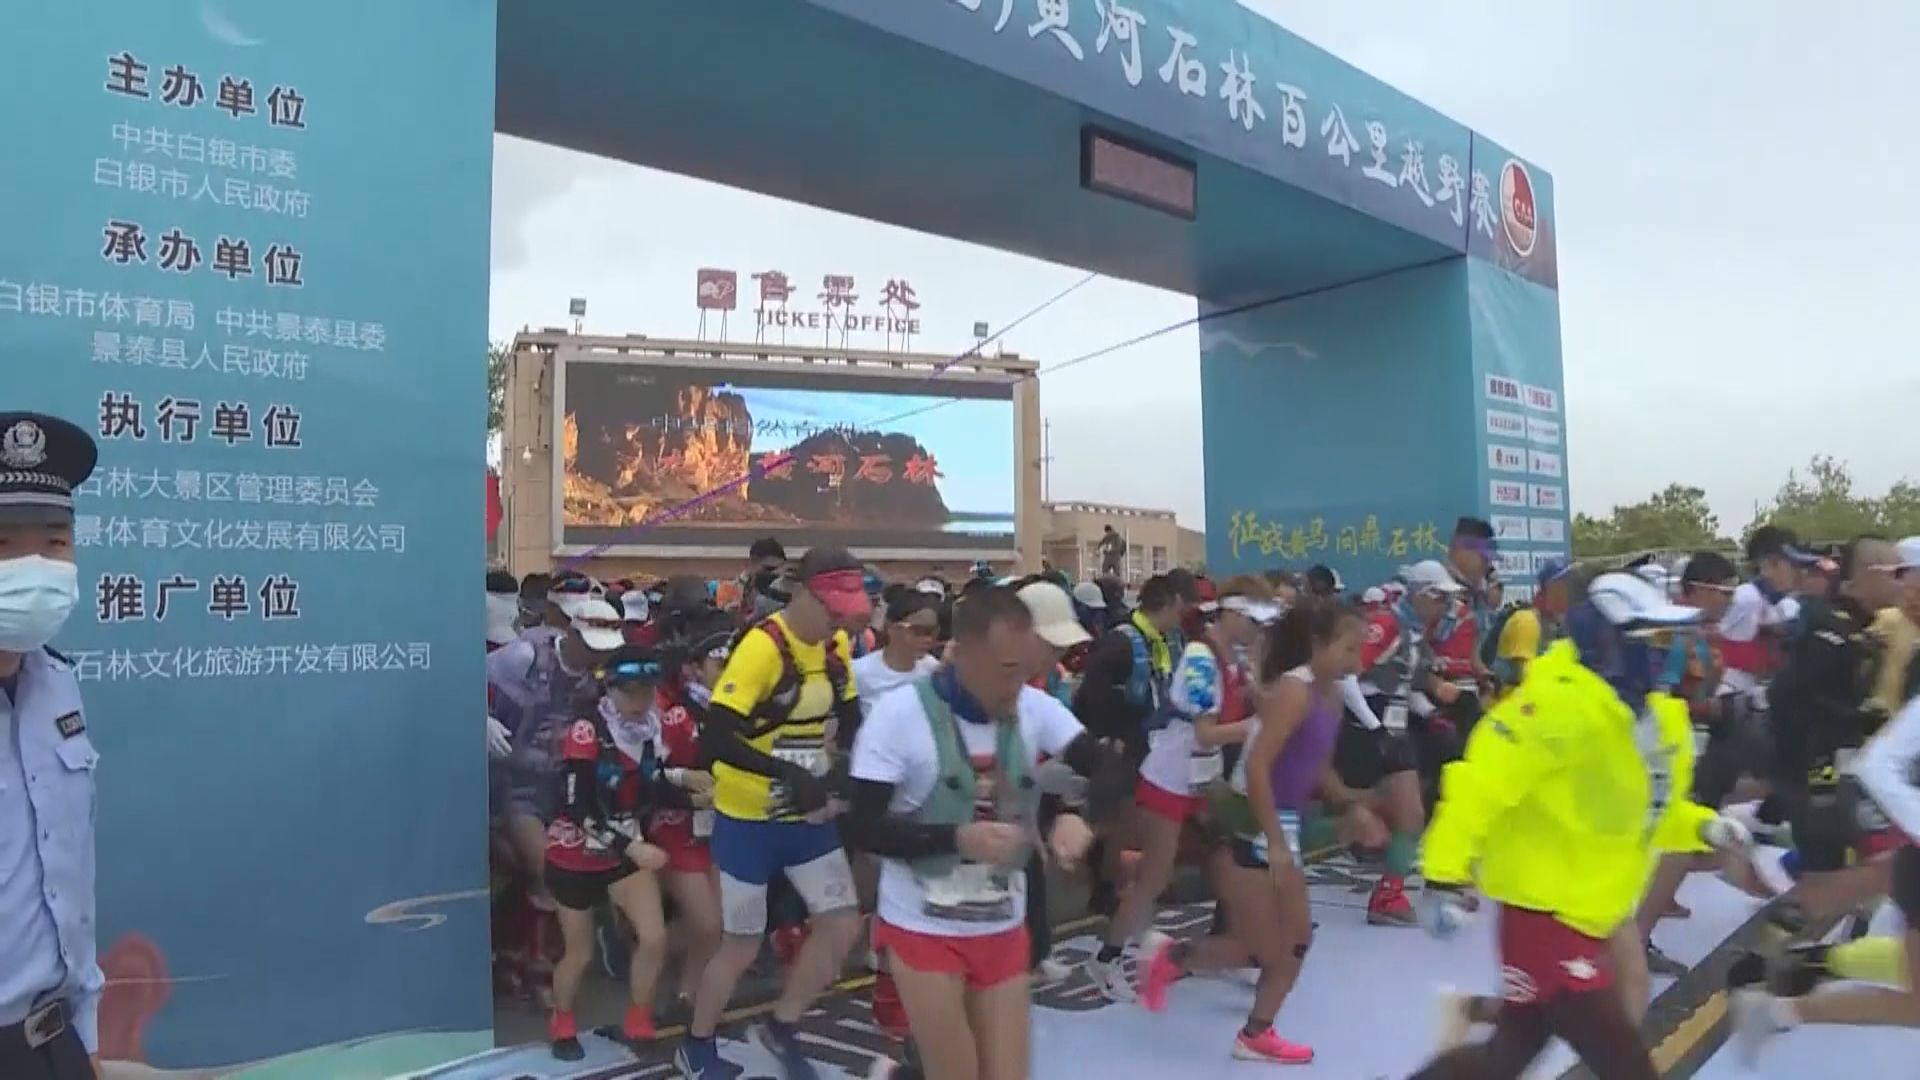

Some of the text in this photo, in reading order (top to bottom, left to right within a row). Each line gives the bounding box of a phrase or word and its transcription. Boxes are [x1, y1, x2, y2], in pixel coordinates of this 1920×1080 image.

[105, 51, 308, 130] 主办单位
[111, 121, 298, 181] 中共白银市委
[94, 157, 312, 217] 白银市人民政府
[102, 219, 305, 287] 承办单位
[0, 279, 386, 352] 白银市体育局 中共景泰县委
[751, 270, 921, 309] 售票处
[753, 308, 921, 335] TICKET OFFICE
[90, 330, 310, 381] 景泰县人民政府
[99, 390, 303, 449] 执行单位
[96, 573, 301, 622] 推广单位
[67, 642, 431, 681] 石林文化旅游开发有限公司
